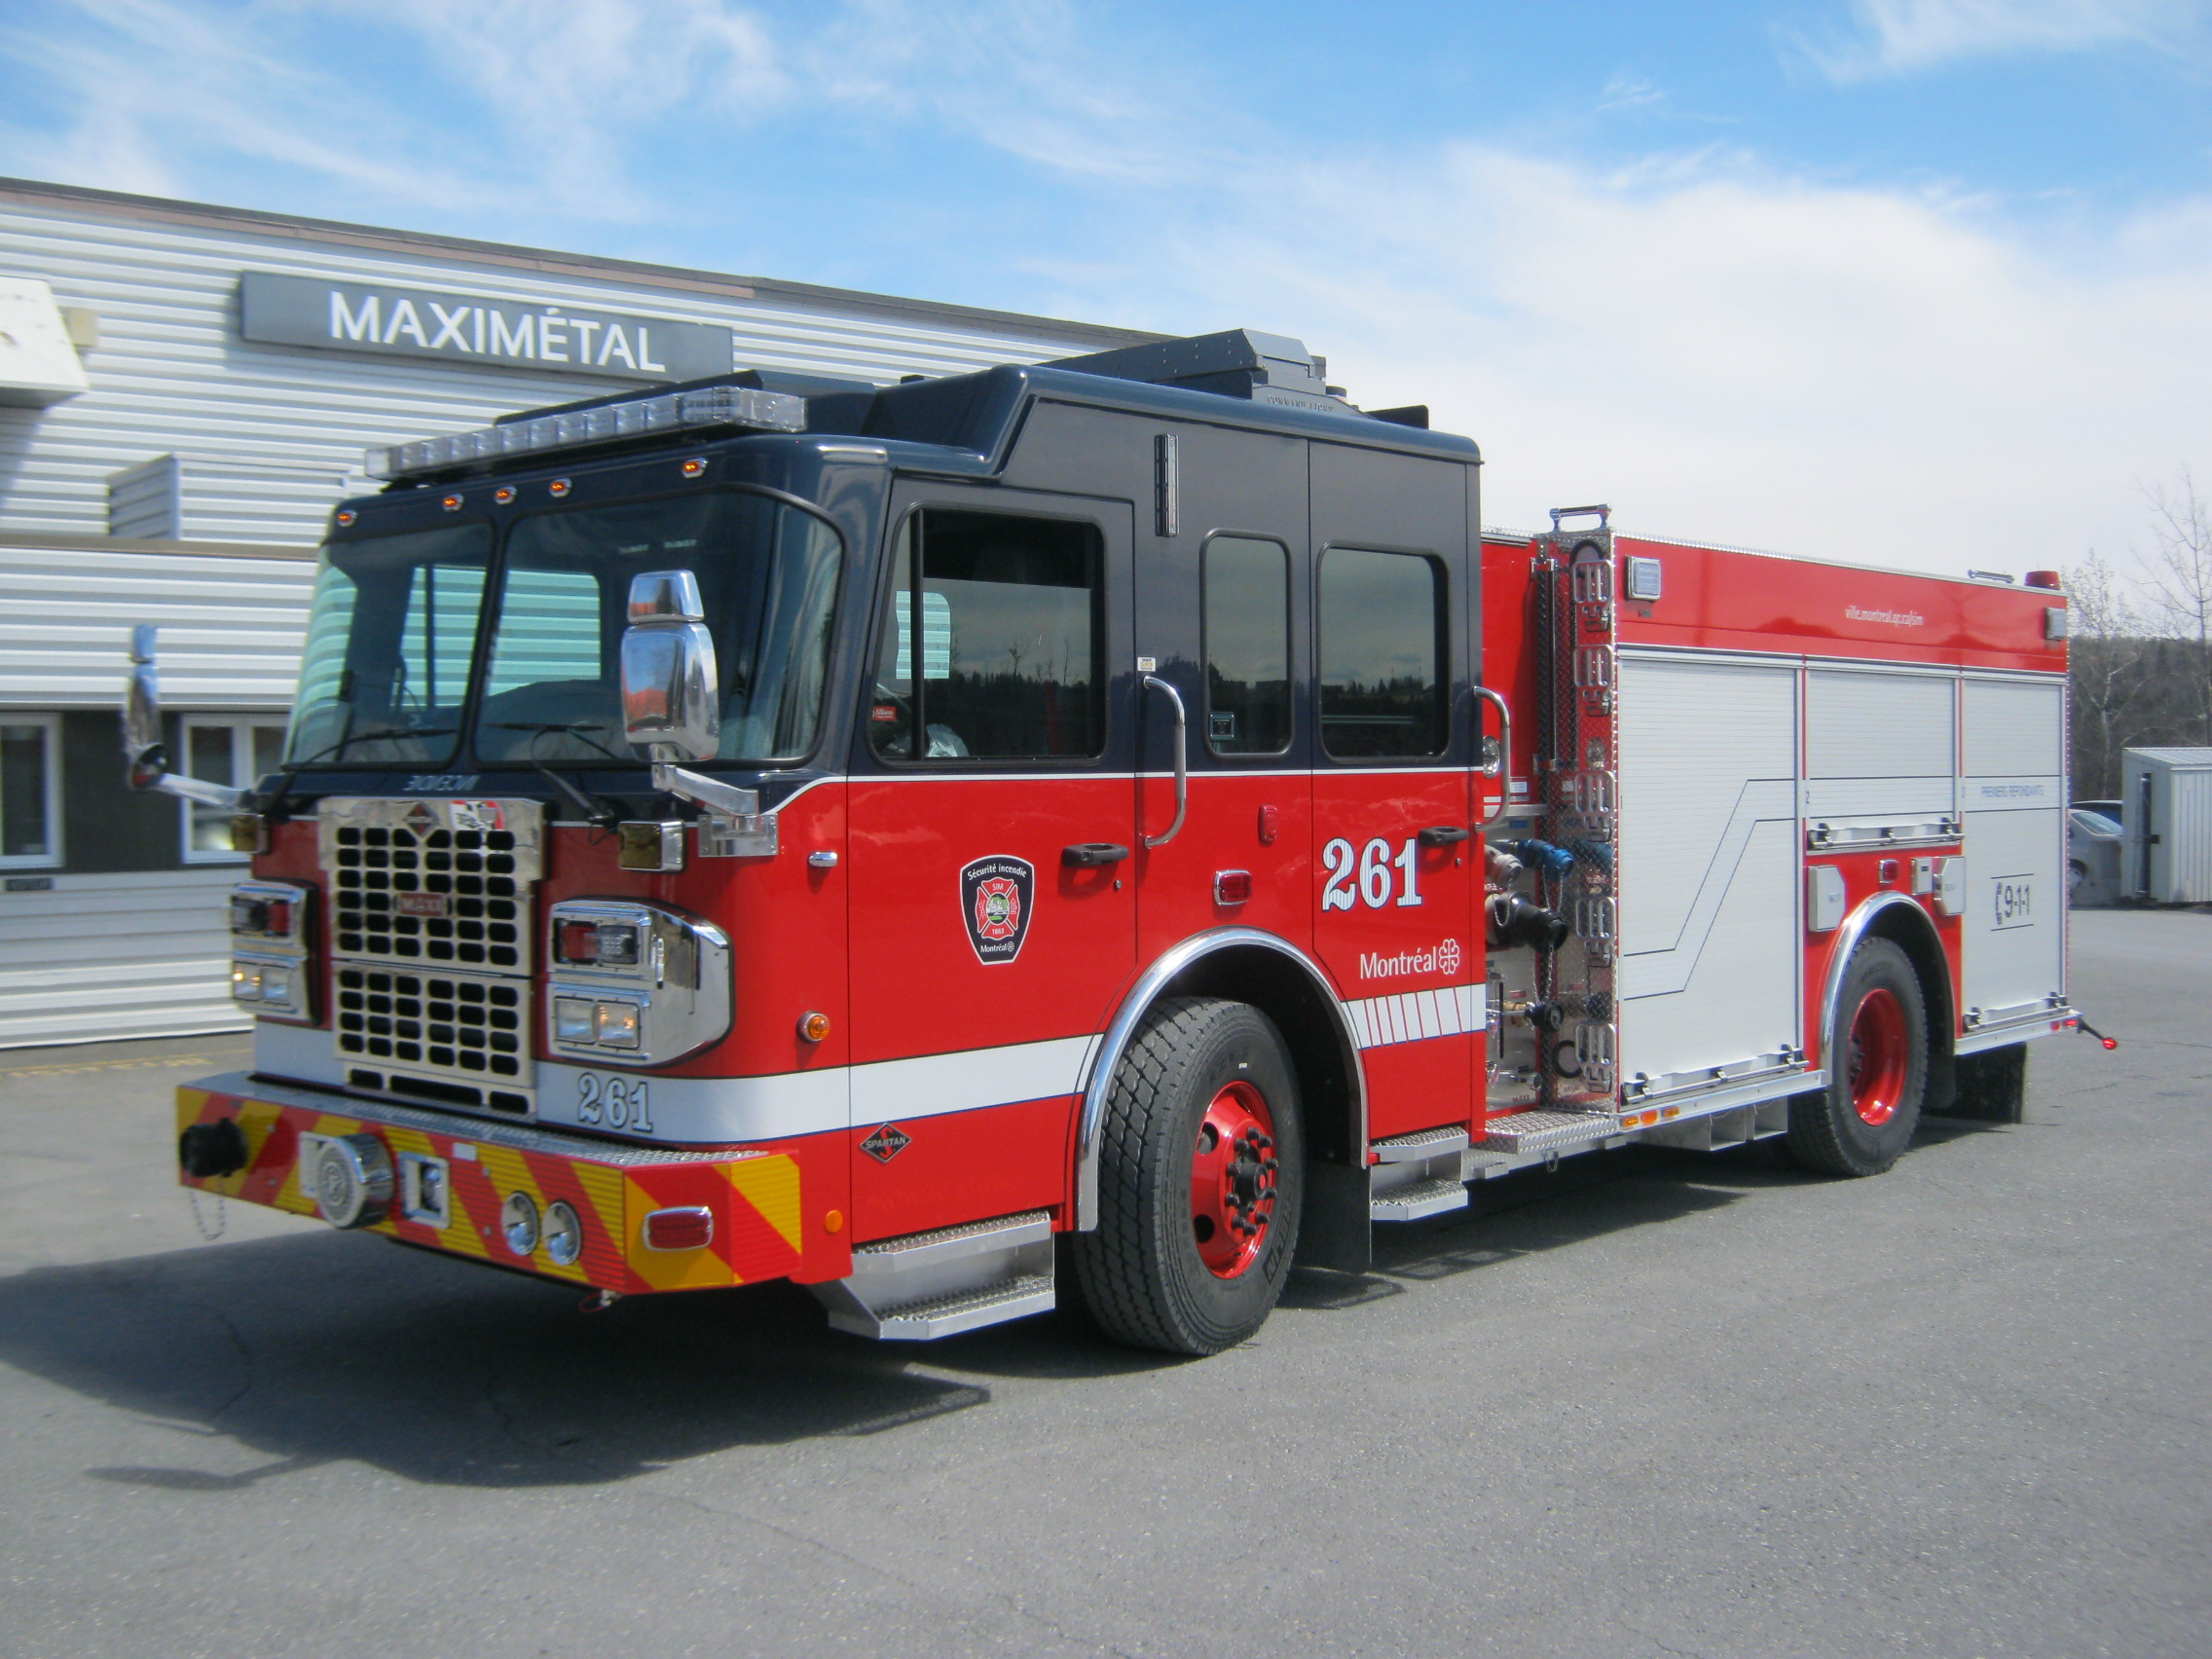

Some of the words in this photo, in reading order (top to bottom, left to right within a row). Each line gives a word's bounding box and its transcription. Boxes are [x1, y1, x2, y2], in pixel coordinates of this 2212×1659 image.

[330, 291, 666, 373] MAXIMÉTAL
[967, 863, 997, 881] Sécurité
[998, 863, 1027, 878] incendie
[1322, 837, 1422, 912] 261
[980, 943, 1008, 953] Montréal
[1360, 945, 1437, 979] Montréal
[577, 1071, 654, 1133] 261
[866, 1136, 906, 1149] SPARTAN
